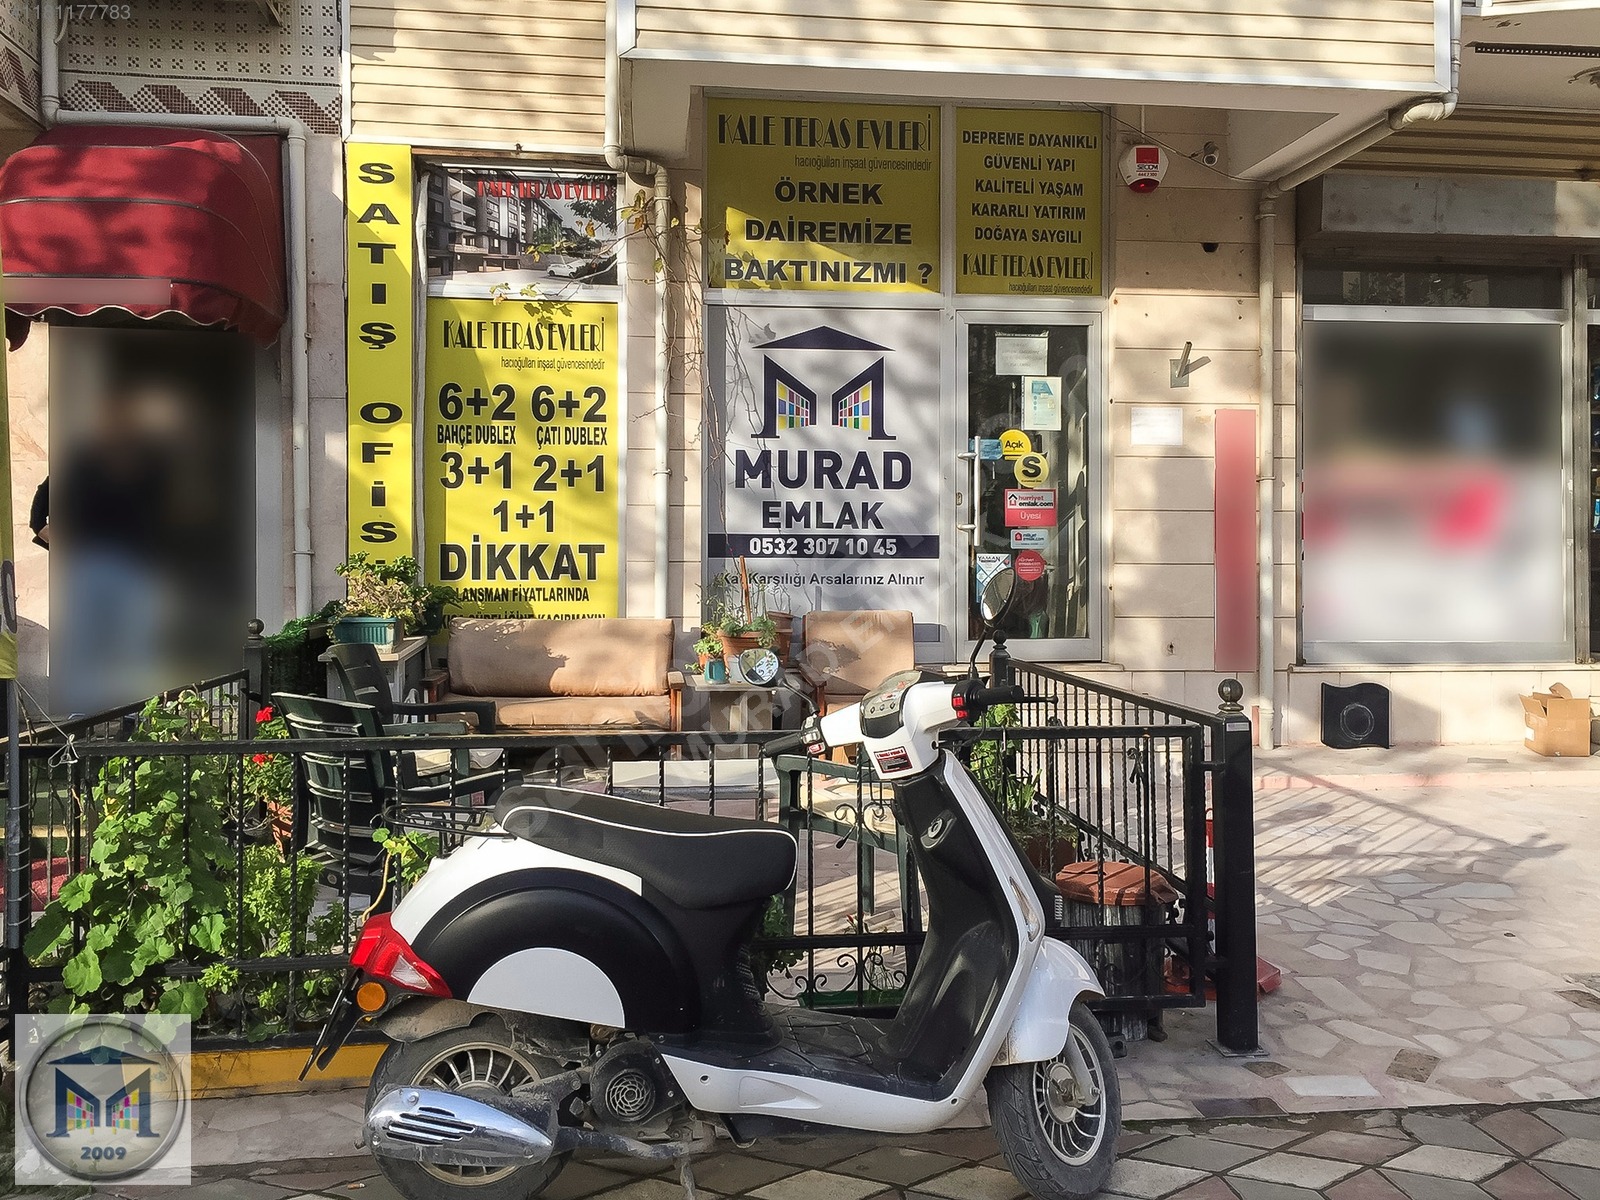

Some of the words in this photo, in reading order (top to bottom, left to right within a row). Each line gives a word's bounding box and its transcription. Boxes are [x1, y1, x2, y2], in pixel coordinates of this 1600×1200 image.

[716, 114, 775, 145] KALE
[781, 117, 850, 149] TERAS
[856, 114, 931, 151] EVLERİ
[962, 130, 1025, 146] DEPREME
[1028, 133, 1097, 149] DAYANIKLI
[842, 157, 867, 171] inşaat
[868, 158, 932, 172] güvencesindedir
[984, 153, 1042, 171] GÜVENLİ
[1046, 158, 1076, 172] YAPI
[518, 180, 562, 201] TERAS
[774, 176, 884, 205] ÖRNEK
[975, 177, 1034, 195] KALİTELİ
[1038, 181, 1084, 199] YAŞAM
[971, 202, 1029, 218] KARARLI
[1033, 205, 1086, 221] YATIRIM
[744, 215, 912, 245] DAİREMİZE
[974, 224, 1028, 242] DOĞAYA
[1031, 228, 1083, 244] SAYGILI
[356, 162, 400, 350] SATIŞ
[963, 253, 999, 276] KALE
[1001, 254, 1044, 279] TERAS
[1046, 251, 1094, 280] EVLERİ
[724, 257, 907, 284] BAKTINIZMI
[443, 320, 488, 349] KALE
[490, 321, 544, 351] TERAS
[547, 317, 604, 352] EVLERİ
[536, 358, 556, 371] inşaat
[556, 359, 605, 372] güvencesindedir
[438, 383, 516, 421] 6+2
[531, 385, 607, 423] 6+2
[437, 424, 473, 449] BAHÇE
[475, 425, 516, 445] DUBLEX
[536, 426, 561, 449] ÇATI
[564, 426, 608, 446] DUBLEX
[1005, 440, 1023, 450] Açık
[440, 452, 512, 490] 3+1
[533, 455, 605, 492] 2+1
[735, 450, 912, 490] MURAD
[1022, 456, 1042, 478] S
[360, 402, 403, 566] OFİS
[493, 500, 554, 532] 1+1
[762, 501, 884, 529] EMLAK
[1020, 511, 1042, 521] Üyesi
[440, 534, 605, 581] DİKKAT
[750, 538, 798, 555] 0532
[803, 539, 839, 555] 307
[846, 539, 868, 555] 10
[873, 539, 897, 556] 45
[724, 573, 747, 584] Ka
[749, 573, 806, 587] Karşılığı
[810, 573, 884, 585] Arsalarınız
[888, 573, 924, 585] Alınır
[512, 584, 589, 602] FİYATLARINDA
